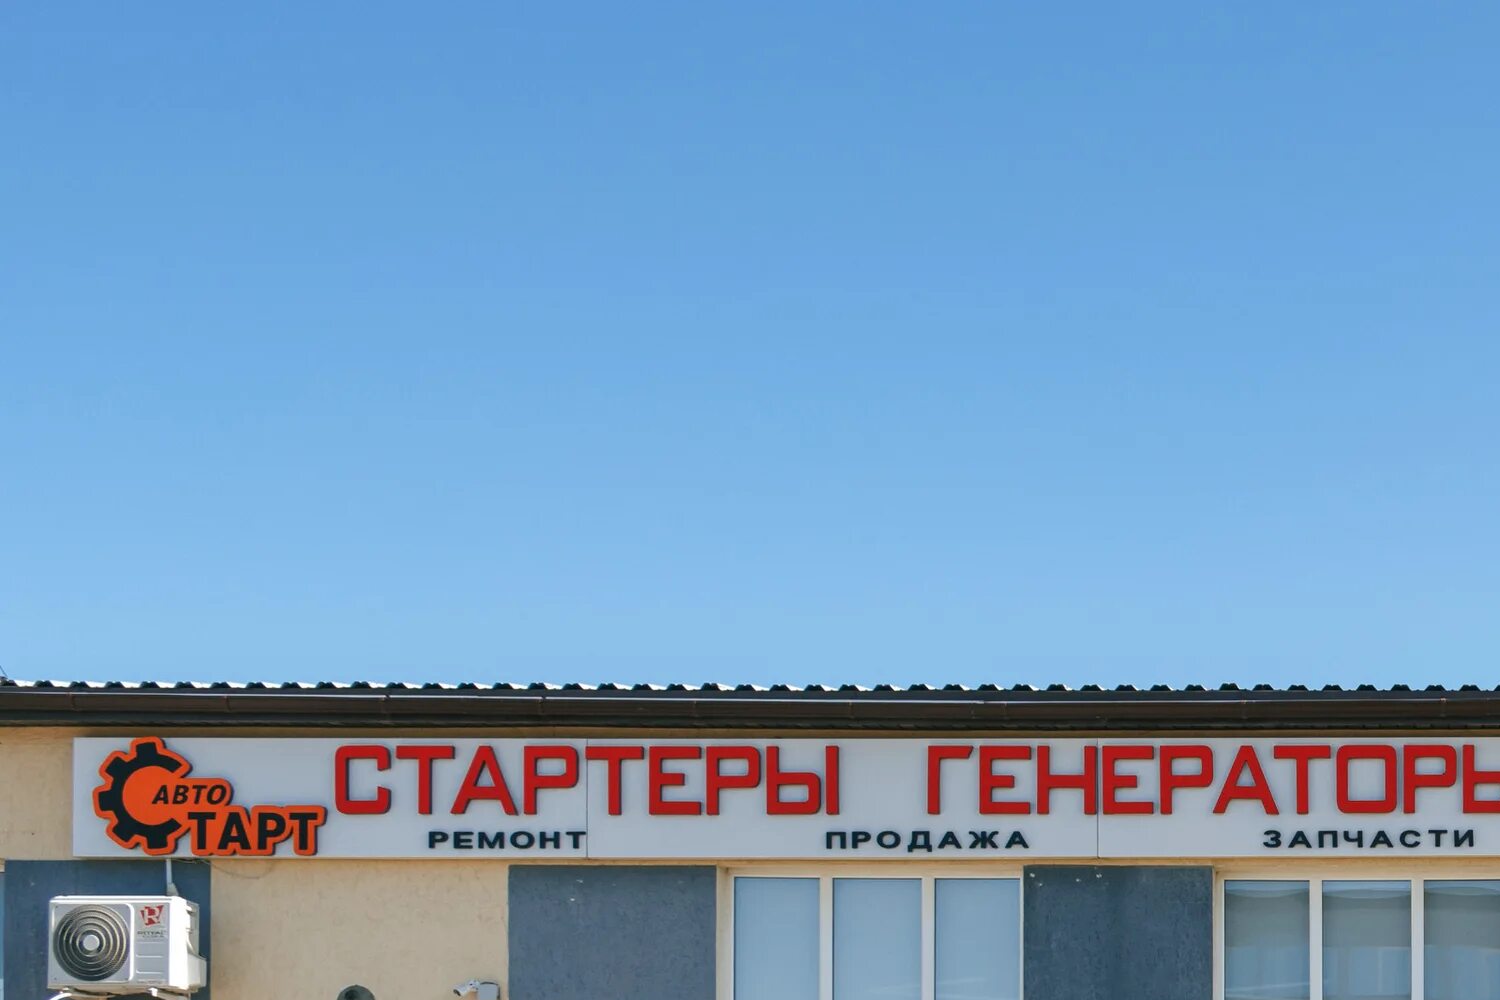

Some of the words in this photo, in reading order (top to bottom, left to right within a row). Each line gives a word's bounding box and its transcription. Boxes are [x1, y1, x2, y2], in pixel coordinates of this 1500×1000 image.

[335, 745, 839, 816] СТАРТЕРЫ
[152, 784, 227, 805] АВТО
[428, 831, 587, 850] РЕМОНТ
[825, 830, 1030, 853] ПРОДАЖА
[1263, 829, 1475, 849] ЗАПЧАСТИ
